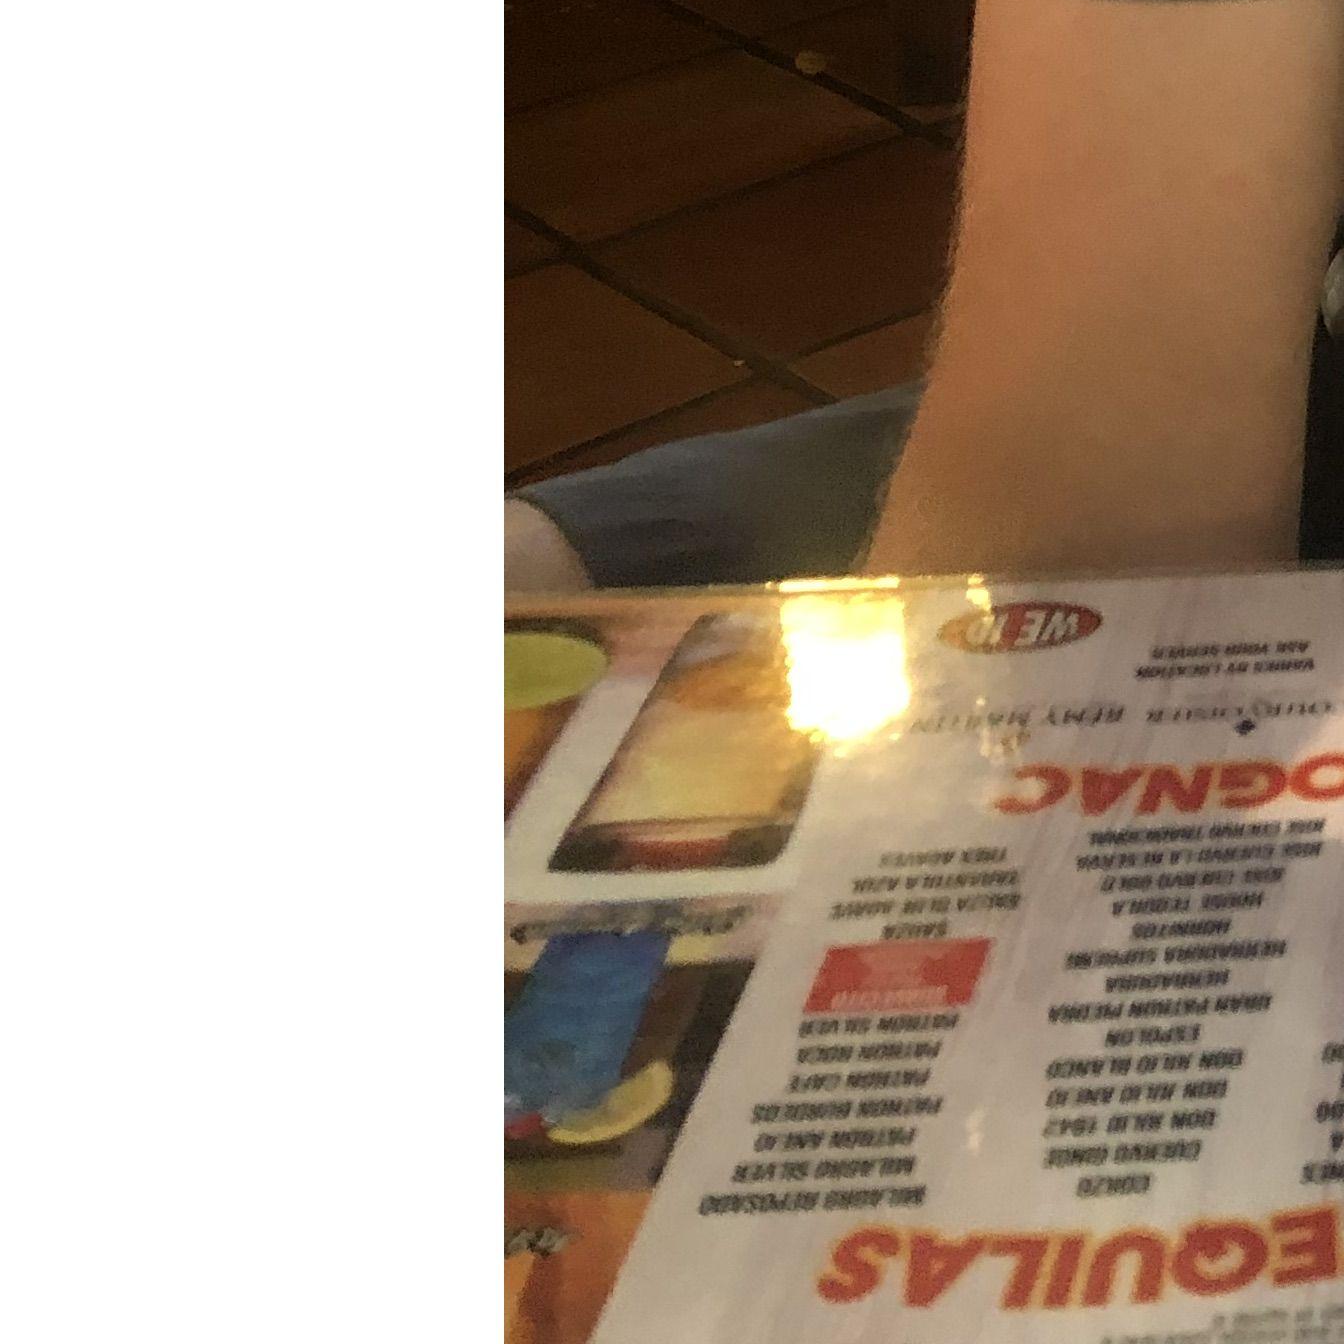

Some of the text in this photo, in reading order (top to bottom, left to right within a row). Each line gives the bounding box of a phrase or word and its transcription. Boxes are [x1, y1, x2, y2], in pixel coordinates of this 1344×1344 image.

[1022, 609, 1081, 645] WE
[1151, 640, 1310, 661] ASK YOUR SERVER
[1135, 657, 1315, 681] VARIES BY LOCATION
[1090, 818, 1326, 846] JOSE CUERVO TRADICIONAL
[1076, 852, 1164, 872] RESERVA
[1197, 845, 1275, 864] CUERVO
[1282, 842, 1322, 860] JOSE
[852, 870, 1020, 894] TARANTULA AZUL
[1157, 870, 1234, 890] CUERVO
[1244, 867, 1285, 885] JOSE
[1112, 897, 1190, 918] TEQUILA
[880, 922, 948, 940] SAUZA
[1131, 919, 1231, 940] HORNITOS
[1164, 939, 1287, 964] HERRADURA
[1105, 969, 1230, 993] HERRADURA
[1048, 1002, 1124, 1024] PIEDRA
[1128, 998, 1209, 1018] PATRON
[798, 1013, 959, 1039] PATRON SILVER
[1105, 1024, 1201, 1047] ESPOLON
[797, 1041, 942, 1065] PATRON ROCA
[1046, 1049, 1243, 1080] DON JULIO BLANCO
[846, 1068, 931, 1091] PATRON
[1183, 1079, 1227, 1100] DON
[1119, 1082, 1176, 1105] JULIO
[751, 1097, 943, 1125] PATRON BURDEOS
[1171, 1109, 1216, 1132] DON
[1106, 1113, 1164, 1135] JULIO
[829, 1127, 917, 1150] PATRON
[1114, 1139, 1202, 1165] CUERVO
[731, 1156, 915, 1184] MILAGRO SILVER
[699, 1185, 926, 1216] MILAGRO REPOSADO
